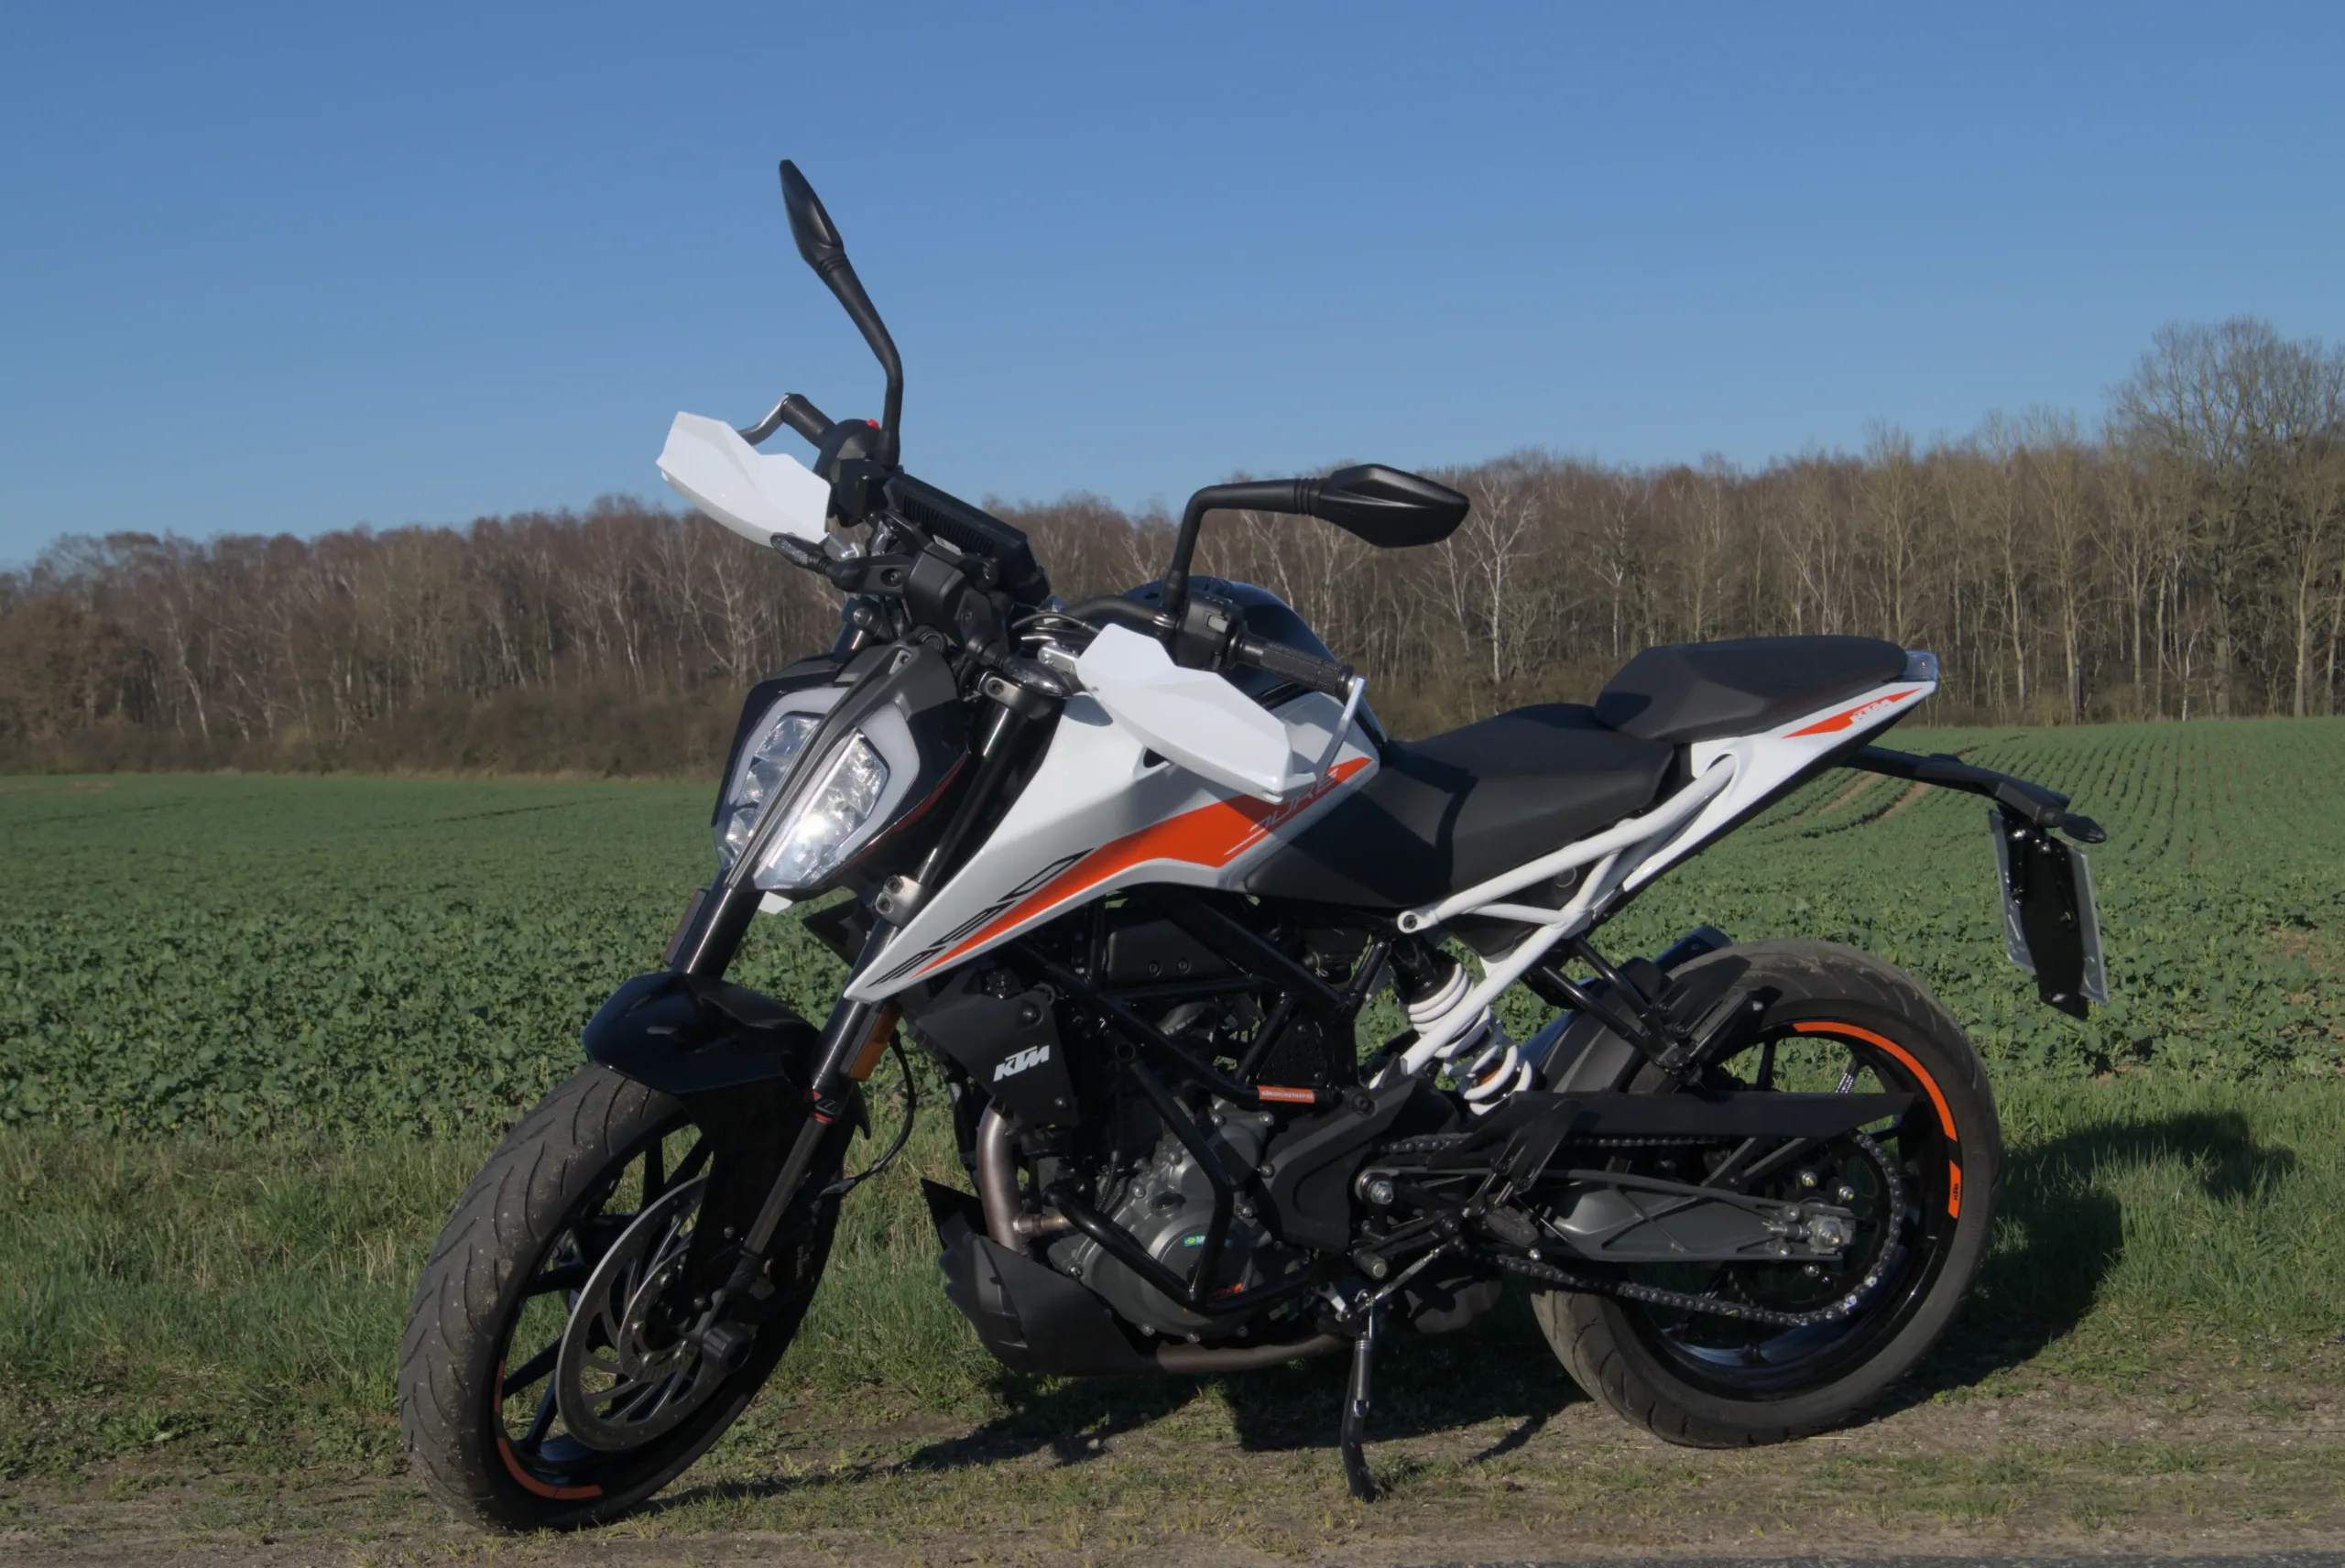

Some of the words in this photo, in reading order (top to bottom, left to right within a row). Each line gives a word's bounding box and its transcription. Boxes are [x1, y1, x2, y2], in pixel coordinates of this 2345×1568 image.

[1849, 699, 1894, 724] KTM
[1224, 768, 1339, 855] DUKE
[865, 847, 1094, 988] 390
[993, 1045, 1050, 1082] KTM
